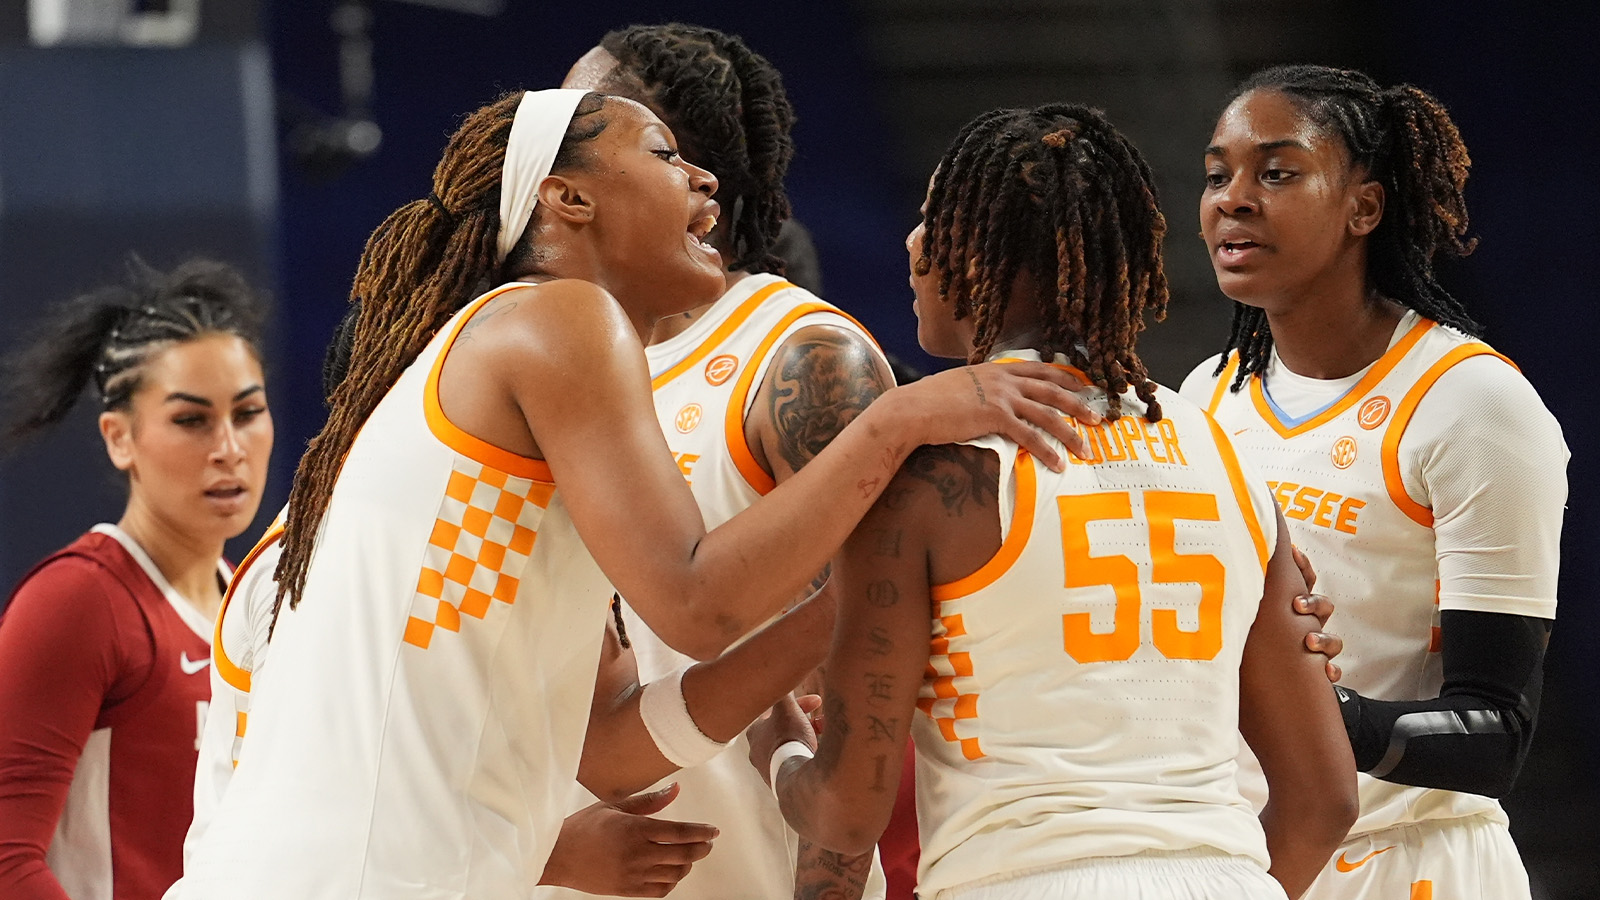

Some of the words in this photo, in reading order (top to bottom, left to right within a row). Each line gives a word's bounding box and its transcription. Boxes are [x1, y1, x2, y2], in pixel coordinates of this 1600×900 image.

[1333, 438, 1356, 466] SEC
[1266, 480, 1367, 535] SSEE
[1056, 490, 1226, 664] 55
